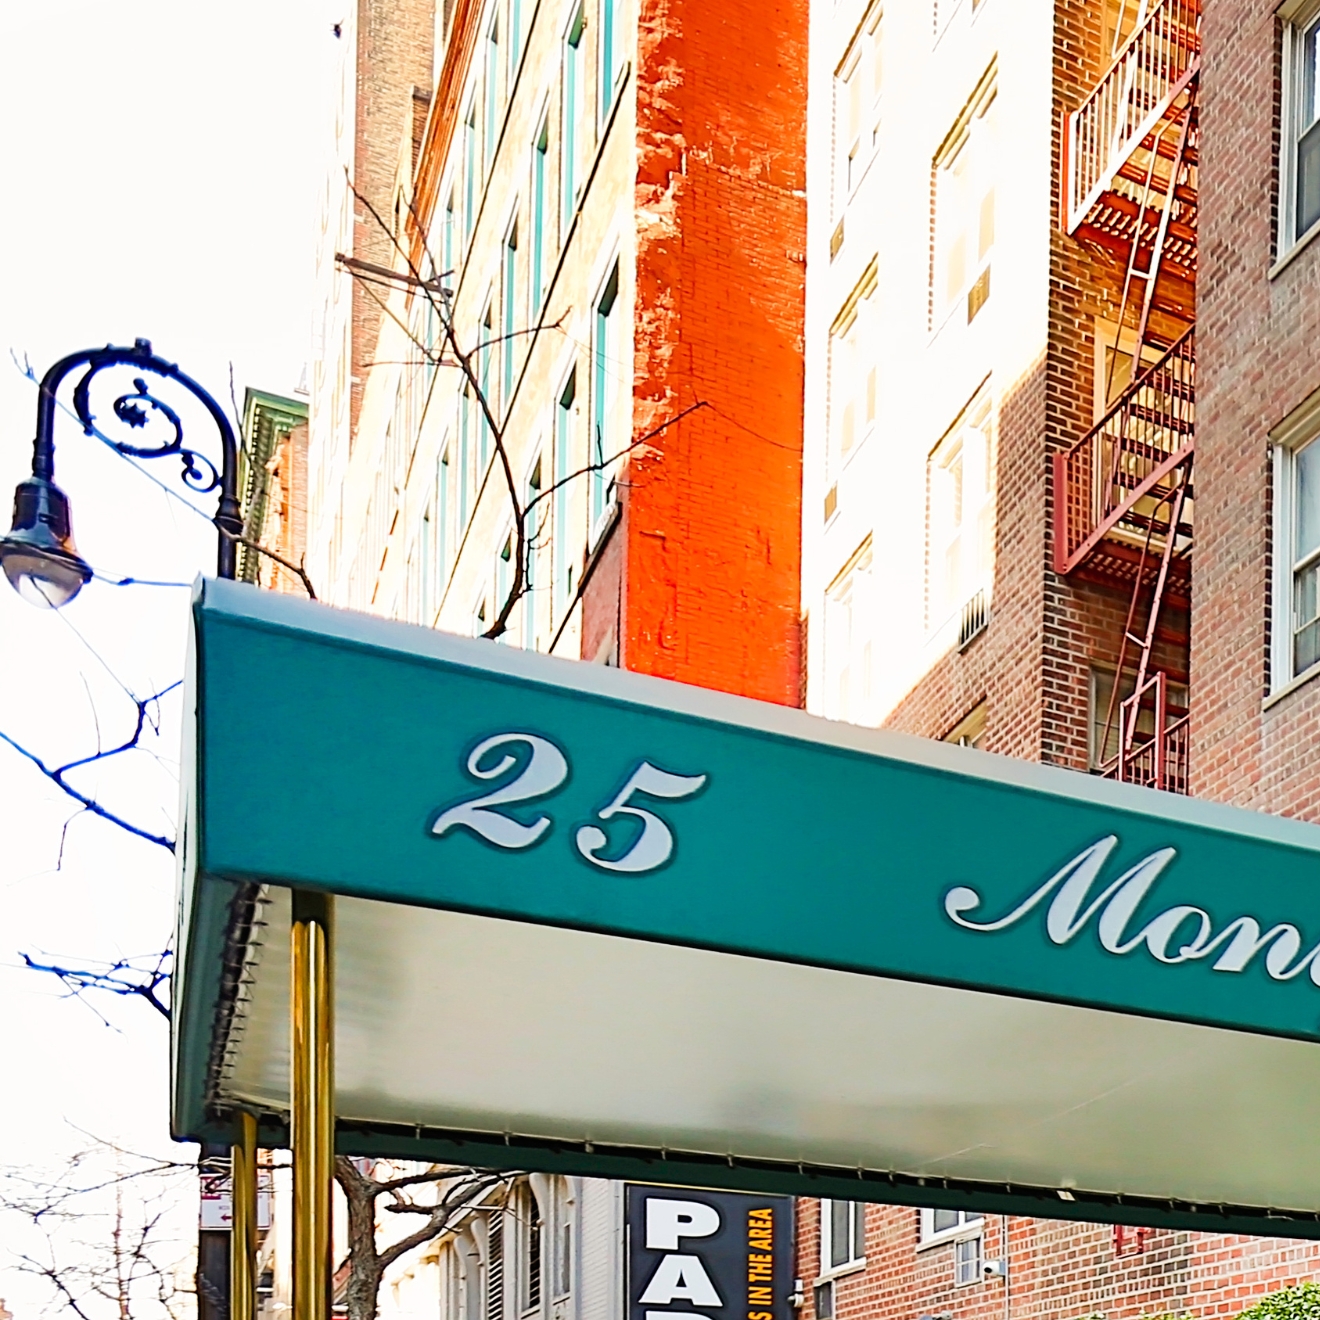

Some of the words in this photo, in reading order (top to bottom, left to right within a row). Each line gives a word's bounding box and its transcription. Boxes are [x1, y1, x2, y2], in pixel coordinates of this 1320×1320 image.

[431, 731, 707, 873] 25
[747, 1208, 773, 1251] AREA
[747, 1253, 773, 1283] THE
[747, 1285, 773, 1306] IN
